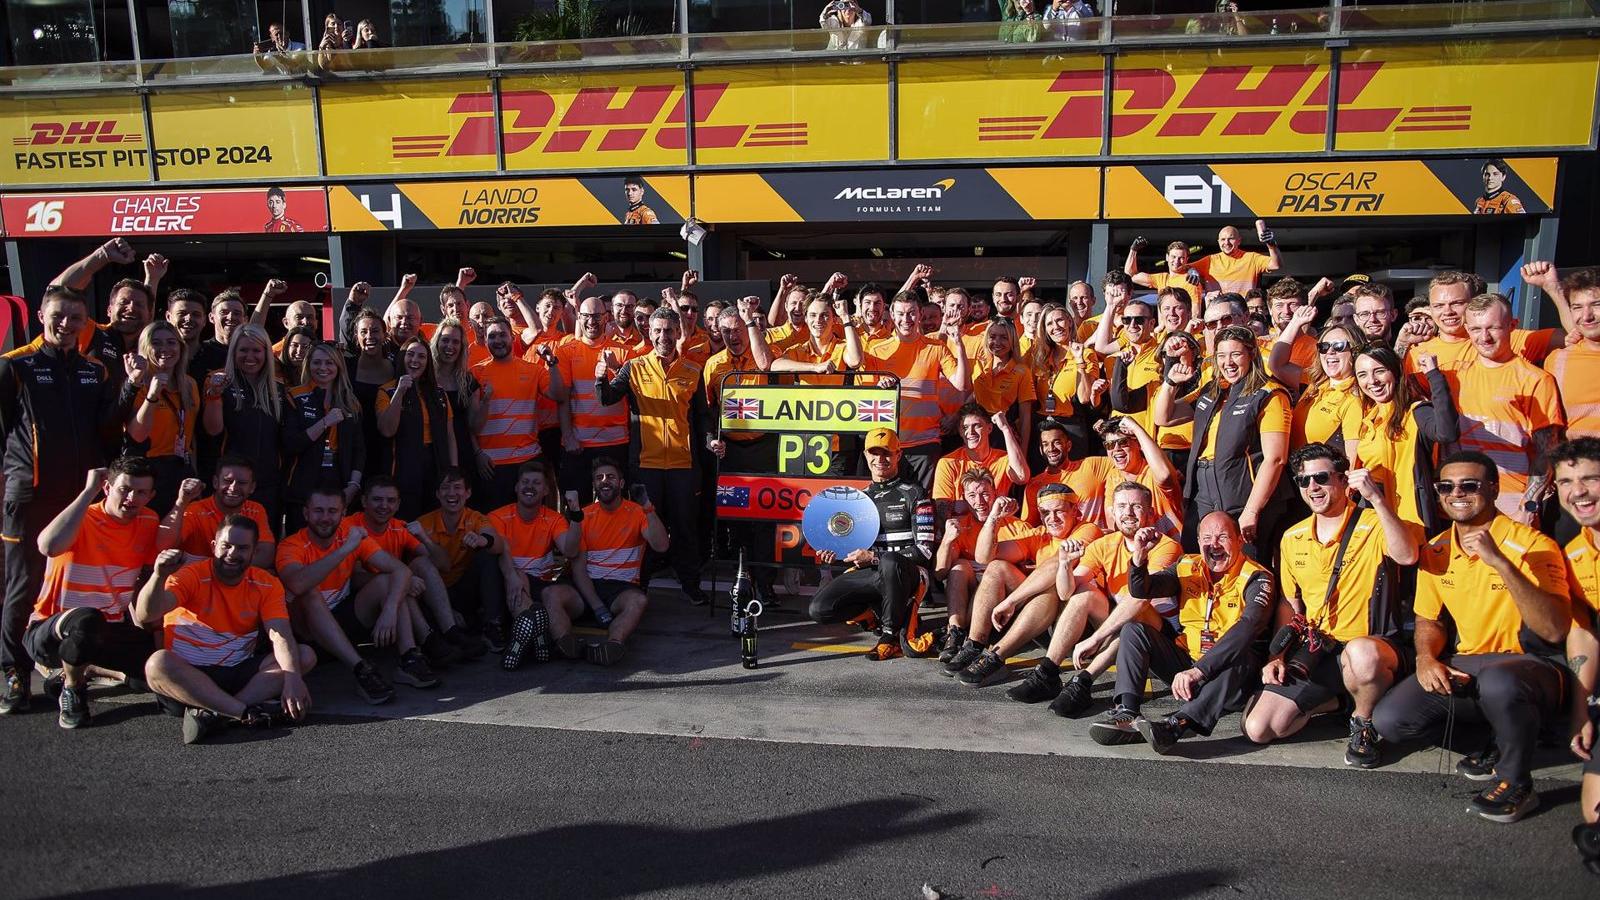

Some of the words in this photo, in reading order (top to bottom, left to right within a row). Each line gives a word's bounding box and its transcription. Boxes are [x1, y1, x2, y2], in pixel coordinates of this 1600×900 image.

[1041, 61, 1403, 139] DHL
[446, 83, 749, 157] DHL
[30, 120, 126, 146] DHL
[15, 150, 108, 170] FASTEST
[114, 149, 147, 167] PIT
[153, 147, 211, 166] STOP
[216, 145, 273, 163] 2024
[1285, 171, 1378, 191] OSCAR
[112, 195, 201, 215] CHARLES
[461, 187, 539, 206] LANDO
[833, 186, 943, 201] McLaren
[1163, 173, 1232, 215] 81
[1275, 193, 1385, 213] PIASTRI
[24, 200, 65, 232] 16
[110, 214, 194, 233] LECLERC
[458, 207, 541, 226] NORRIS
[758, 399, 857, 422] LANDO
[779, 434, 831, 475] P3
[759, 486, 812, 511] OSC
